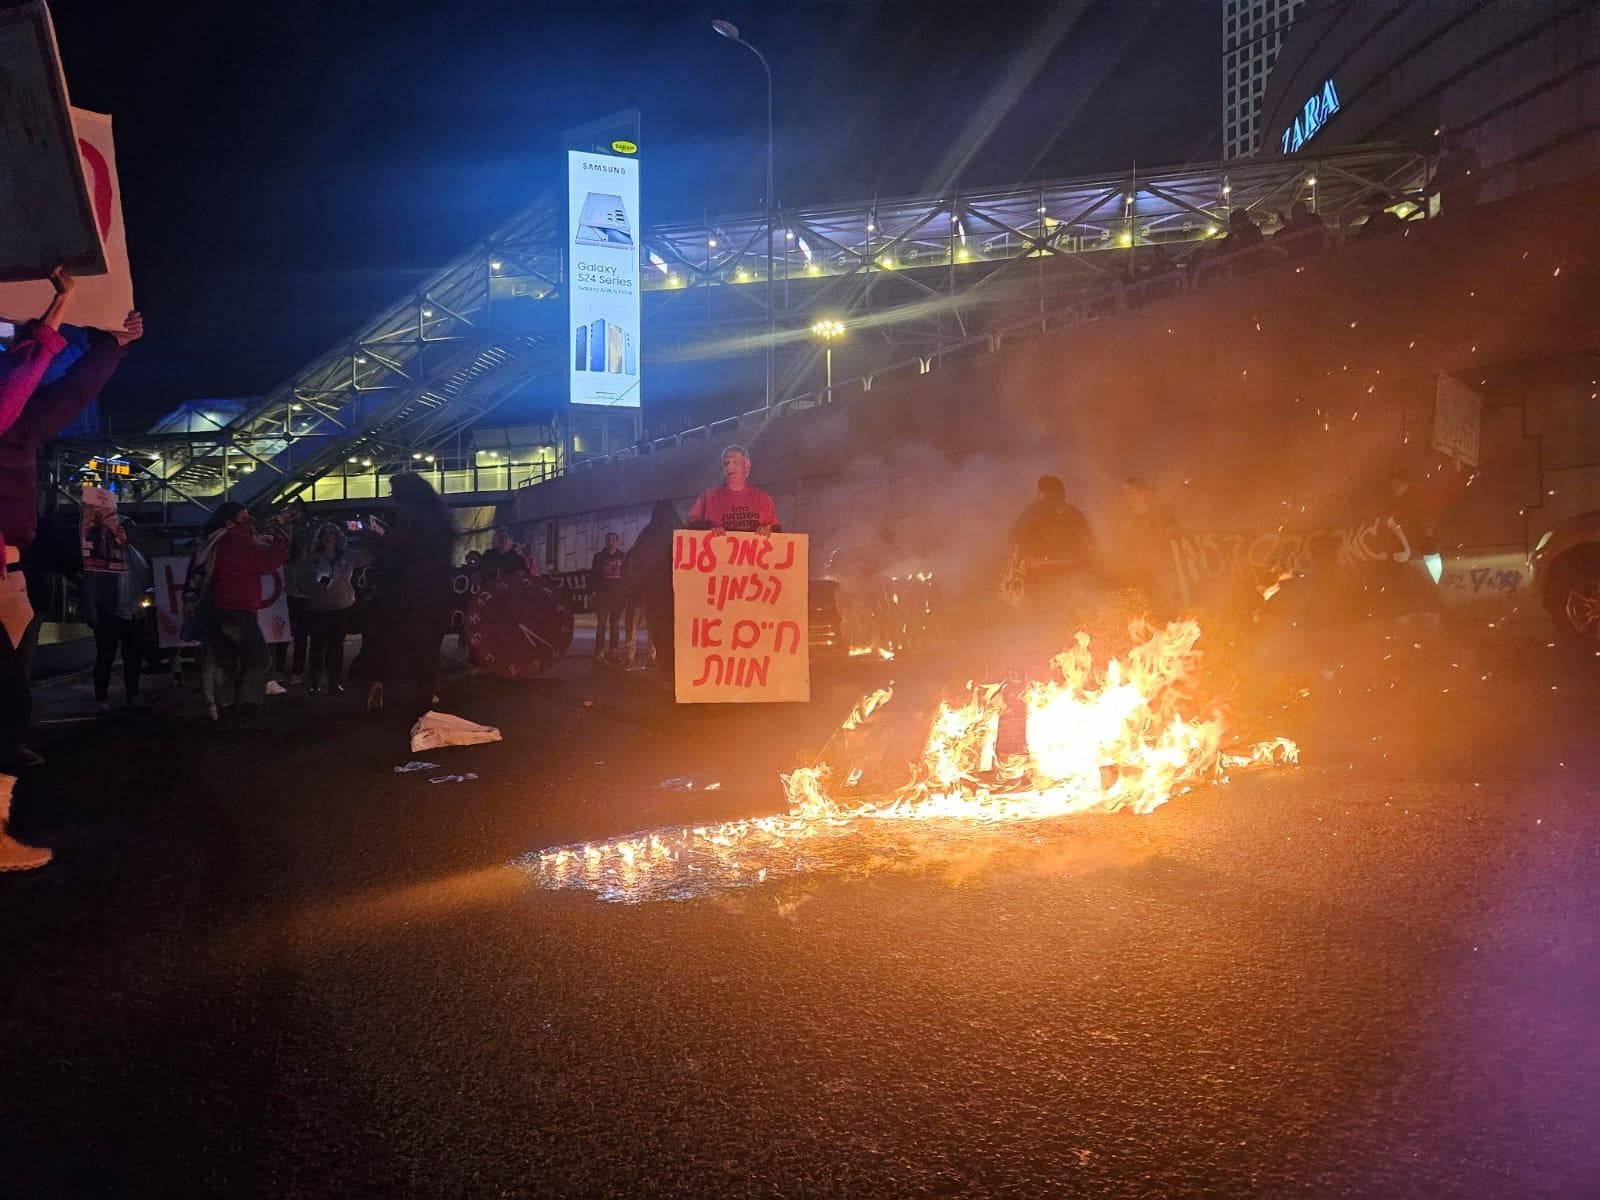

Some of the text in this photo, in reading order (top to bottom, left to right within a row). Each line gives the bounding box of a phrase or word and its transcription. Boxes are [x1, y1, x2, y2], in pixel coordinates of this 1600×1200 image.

[582, 162, 626, 174] SAMSUNG
[577, 261, 617, 276] Galaxy
[577, 273, 633, 287] S24 Series
[674, 532, 795, 574] נגמר לנו
[705, 573, 783, 611] הזמן!
[691, 618, 801, 655] חיים או
[692, 654, 771, 688] מוות
